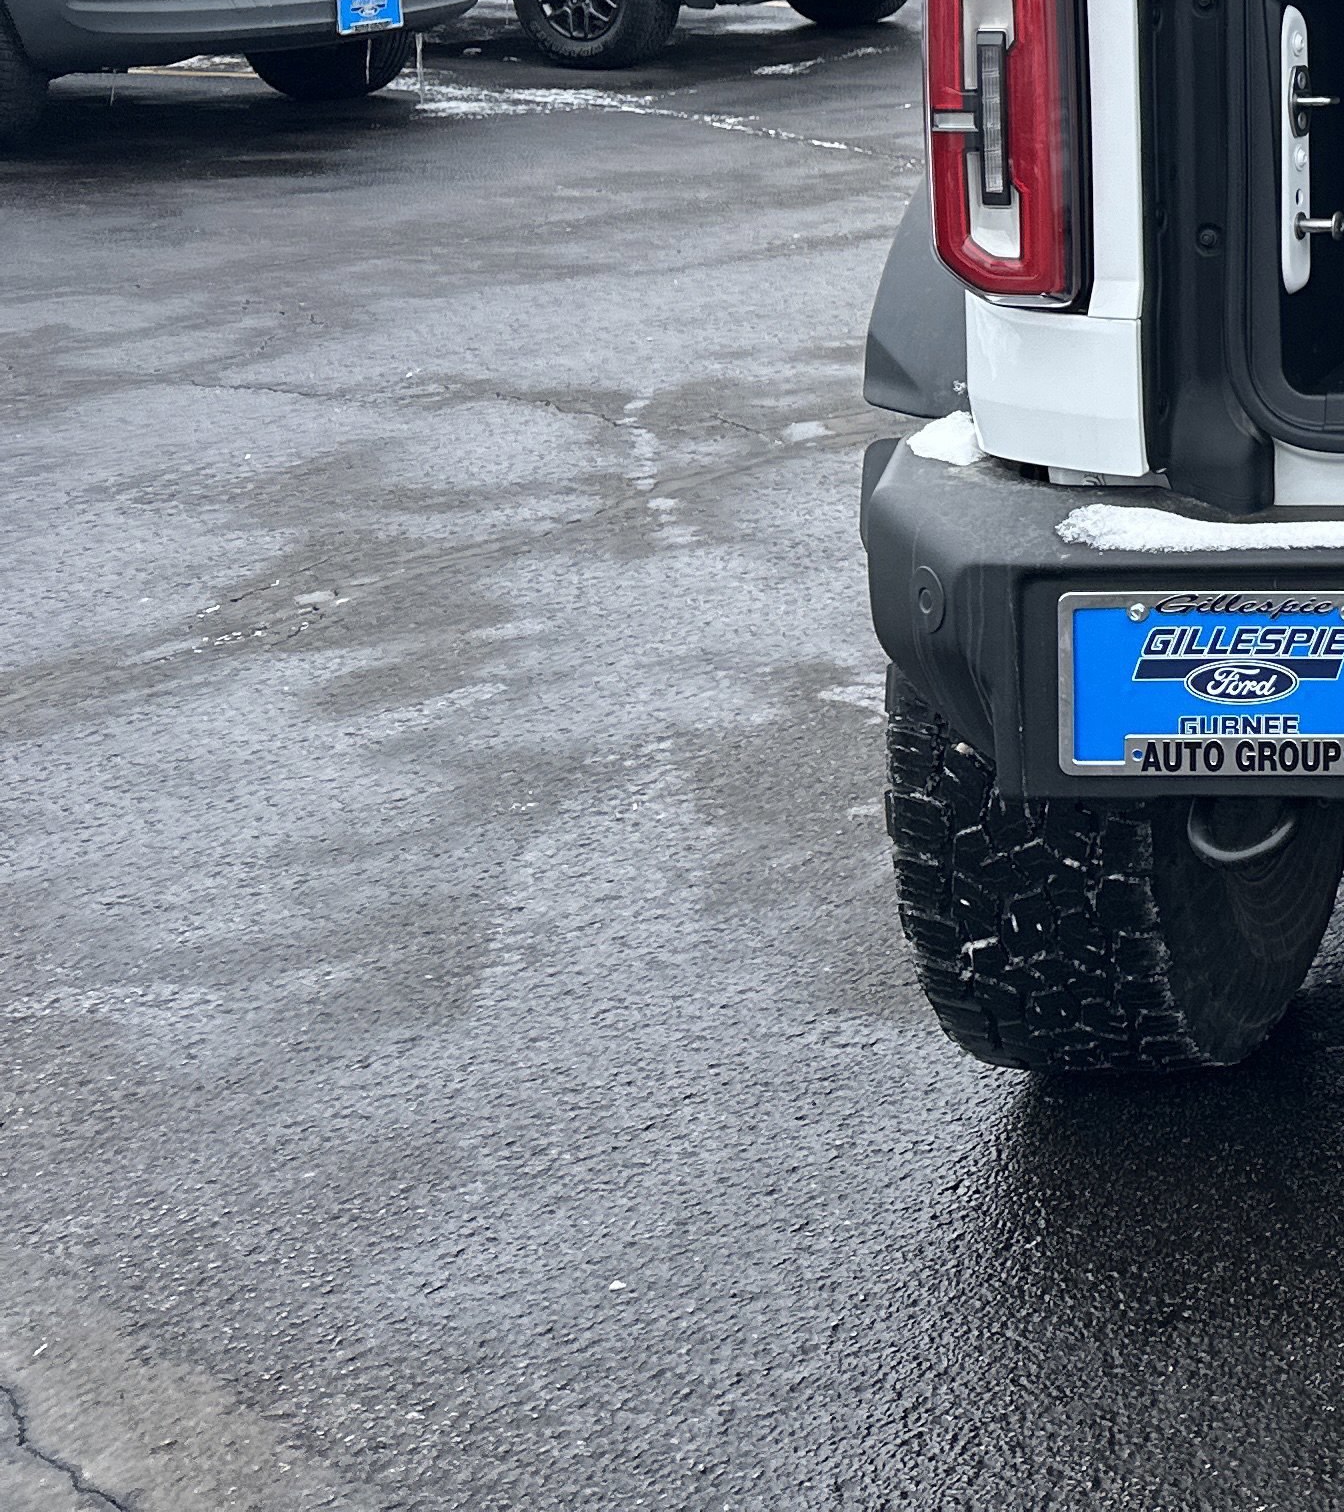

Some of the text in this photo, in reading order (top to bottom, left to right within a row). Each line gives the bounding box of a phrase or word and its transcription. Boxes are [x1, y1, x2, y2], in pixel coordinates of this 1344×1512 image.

[1154, 594, 1334, 619] Gillespie
[1206, 668, 1275, 696] Ford
[1141, 740, 1341, 772] AUTO GROUP
